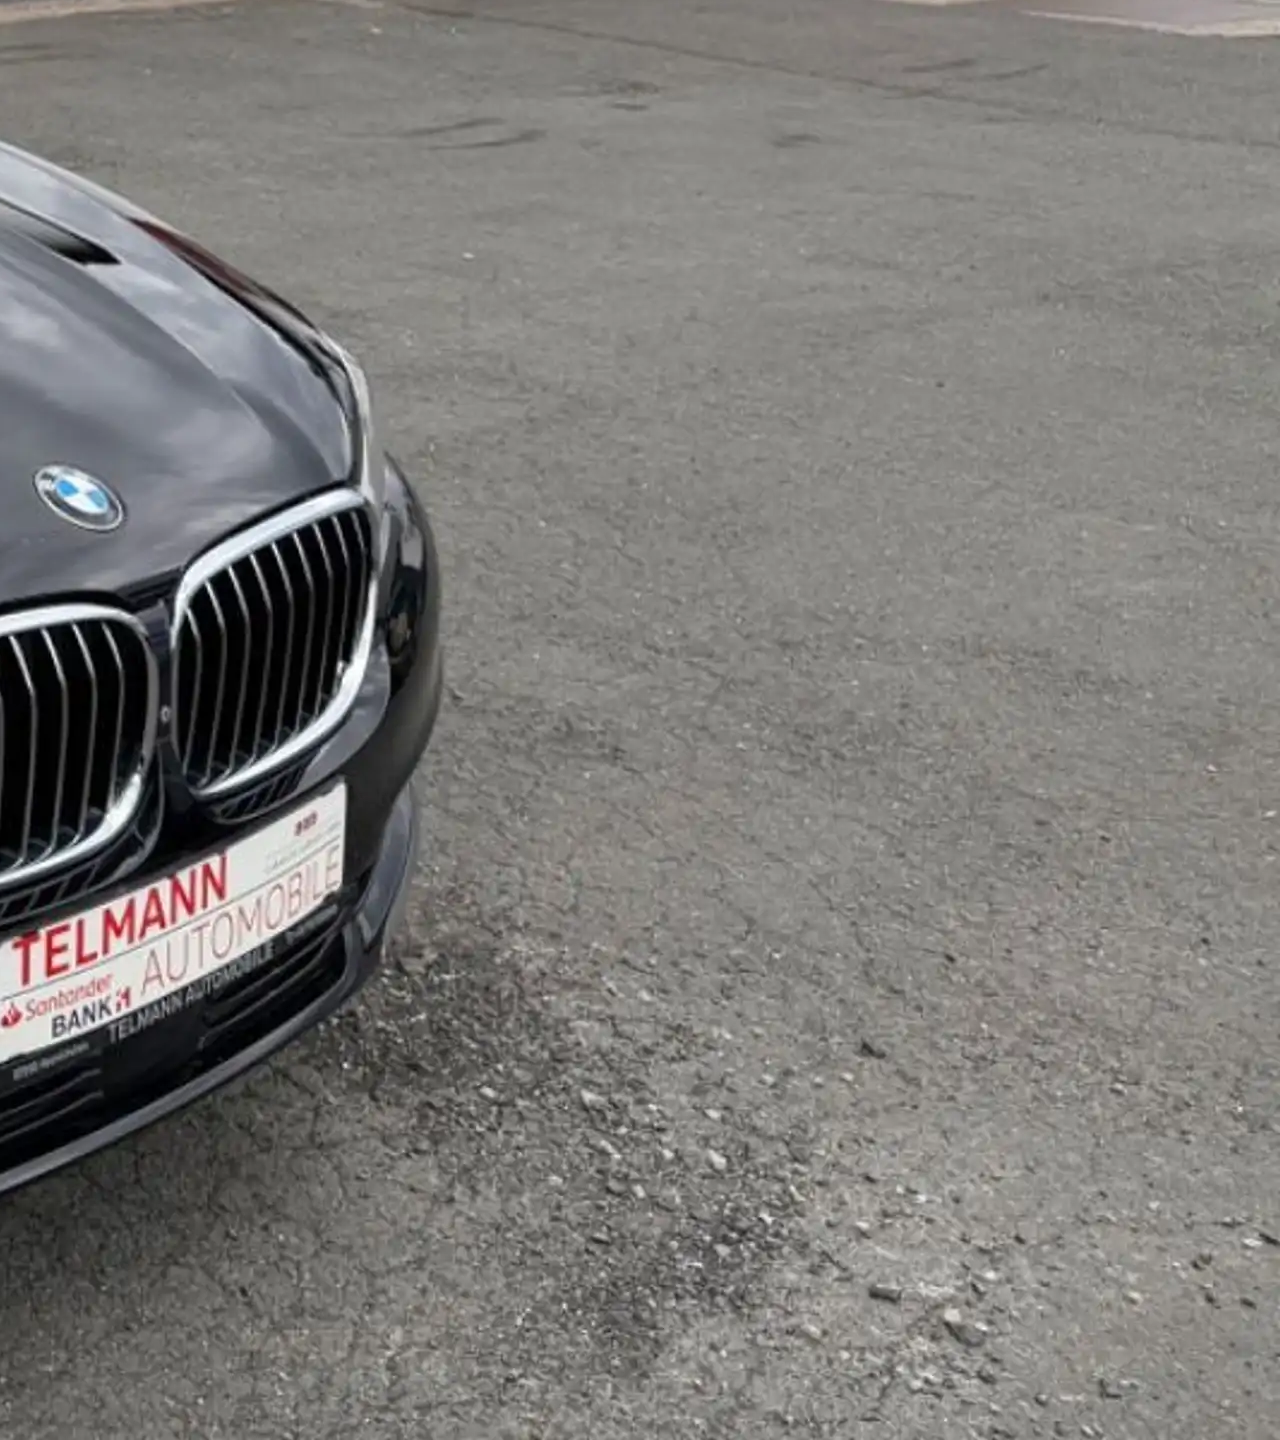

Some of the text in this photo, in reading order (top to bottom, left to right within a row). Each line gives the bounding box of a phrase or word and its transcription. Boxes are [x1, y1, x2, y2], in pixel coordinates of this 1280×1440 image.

[12, 856, 228, 986] TELMANN
[141, 843, 340, 996] AUTOMOBILE
[25, 972, 113, 1023] Santander
[51, 995, 112, 1038] BANK
